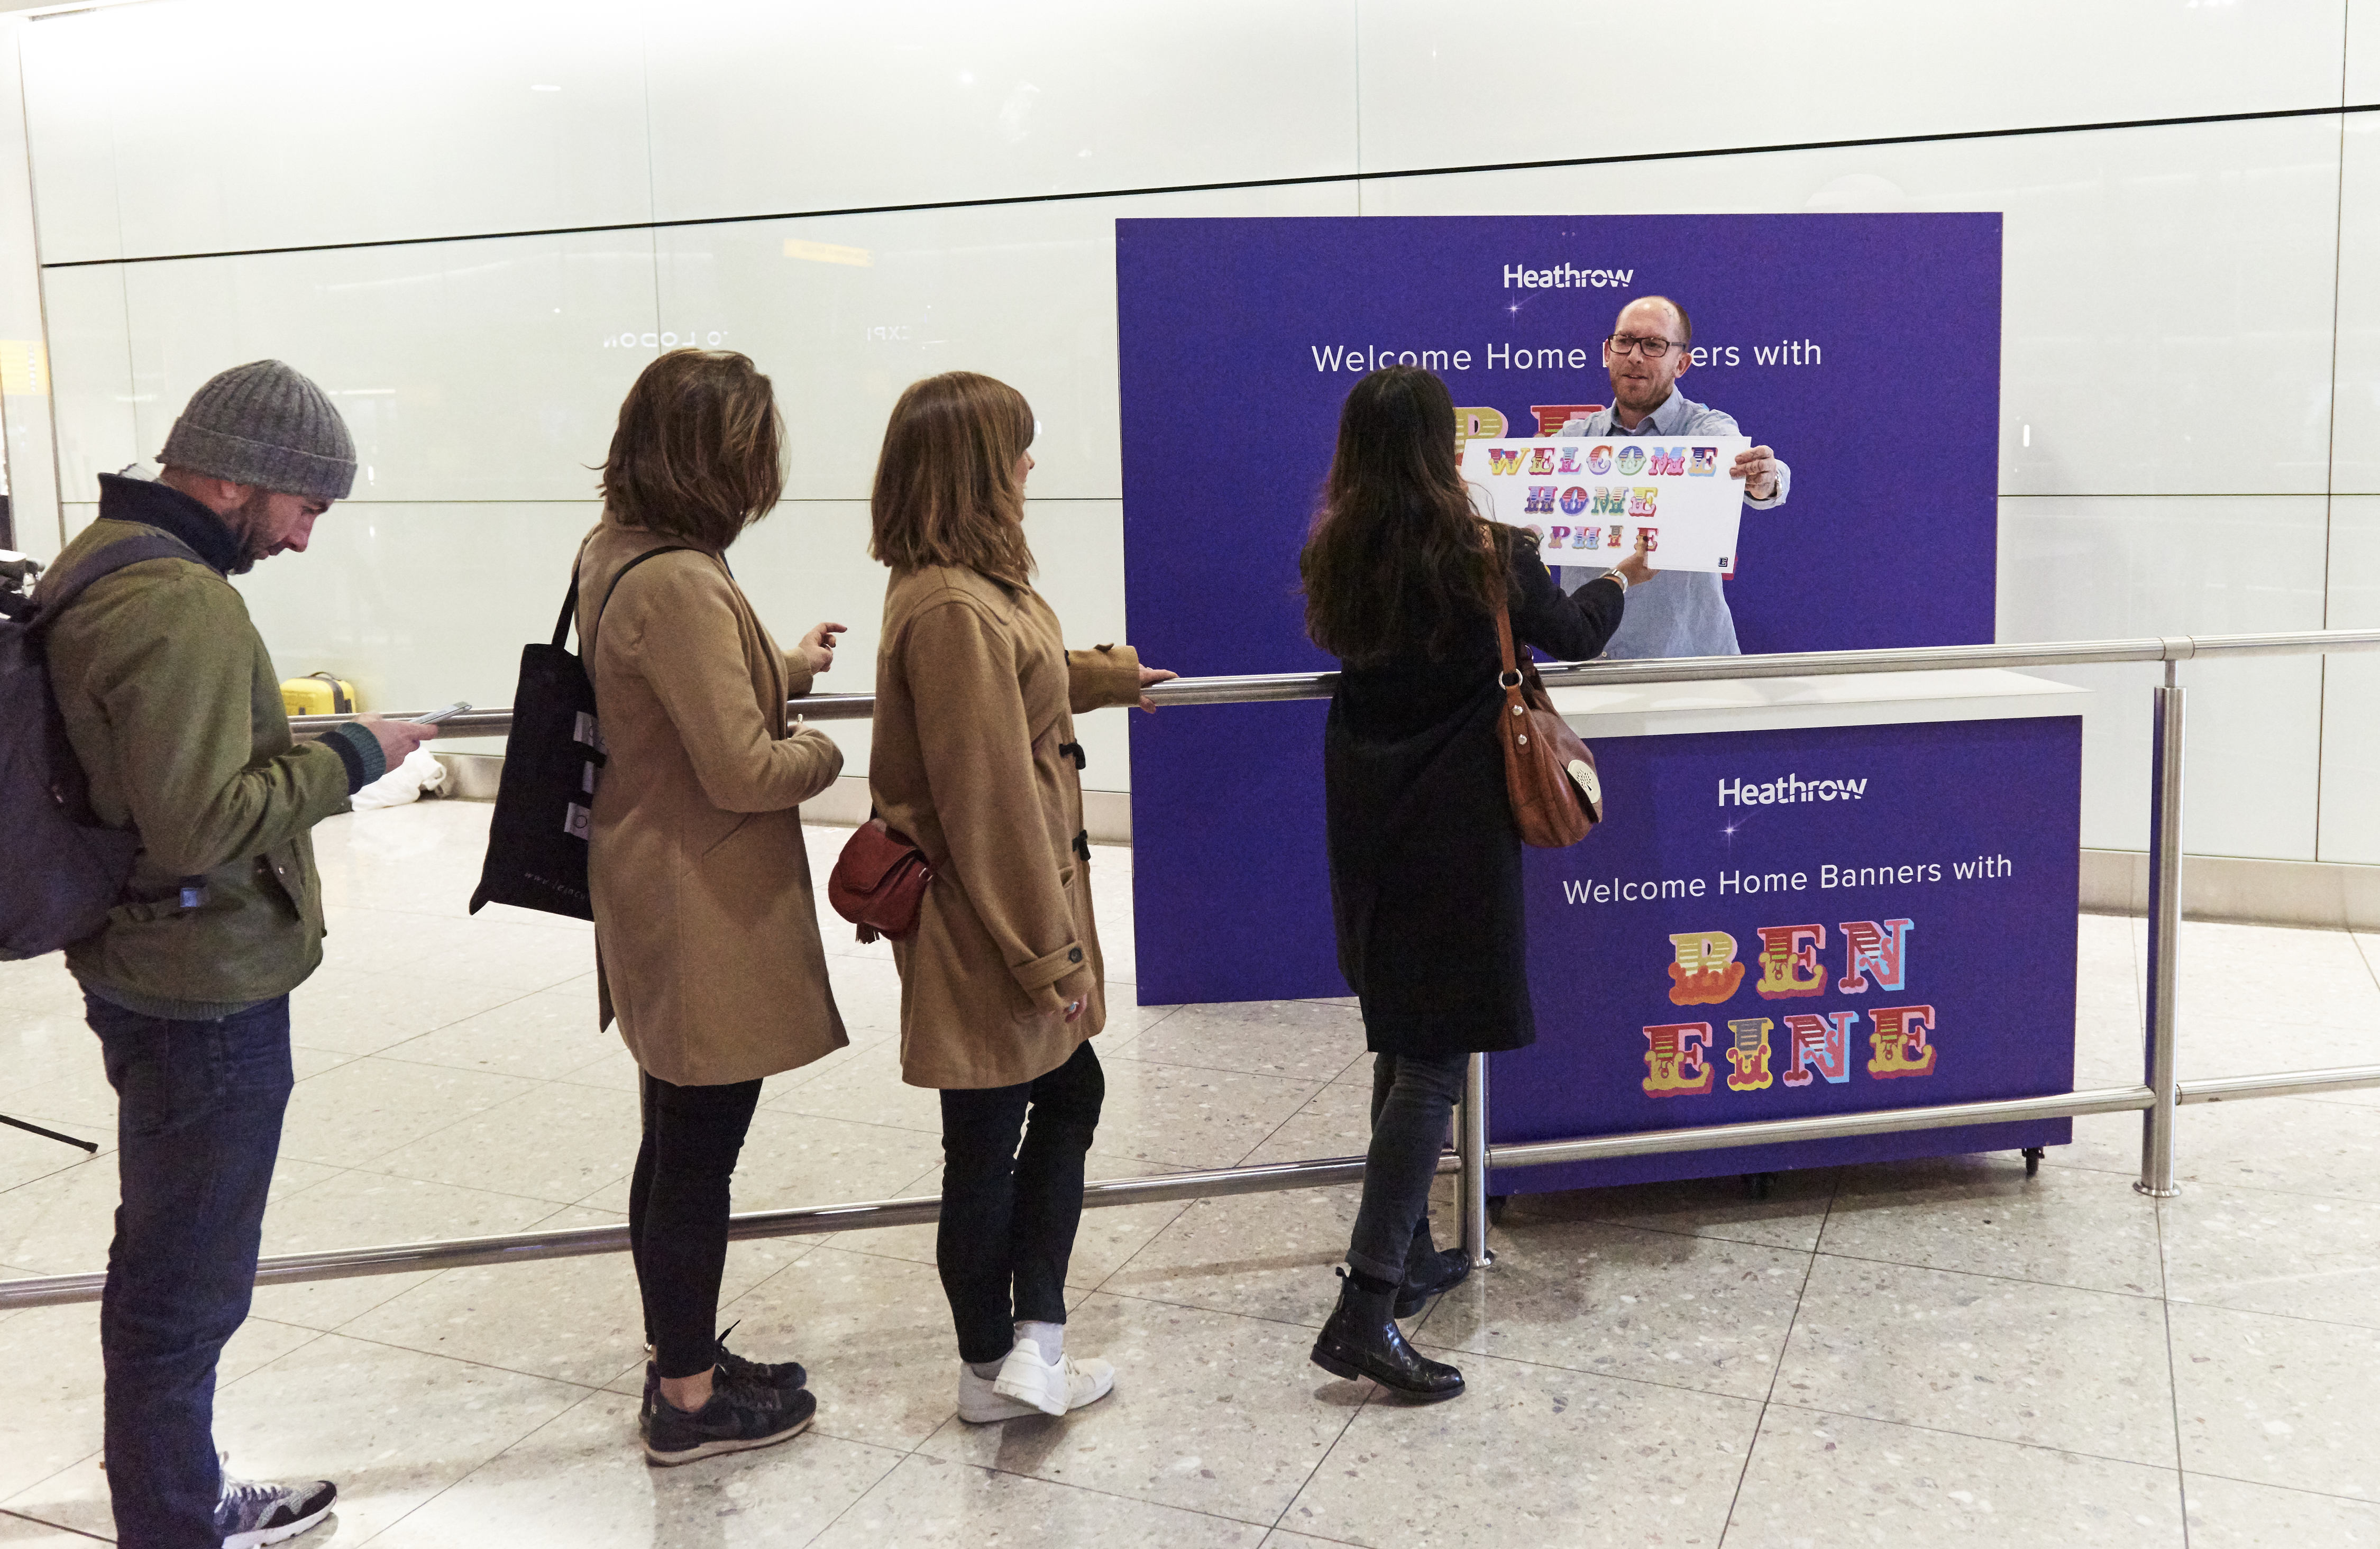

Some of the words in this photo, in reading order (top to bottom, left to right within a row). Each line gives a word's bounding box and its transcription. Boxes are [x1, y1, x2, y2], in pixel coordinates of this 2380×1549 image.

[1504, 262, 1634, 288] Heathrow
[1311, 345, 1471, 371] Welcome
[1487, 343, 1587, 370] Home
[1753, 339, 1821, 365] with
[1488, 445, 1718, 478] WELCOME
[1524, 485, 1659, 518] HOME
[1719, 773, 1867, 806] Heathrow
[1563, 877, 1706, 905] Welcome
[1719, 869, 1808, 895] Home
[1821, 861, 1942, 889] Banners
[1953, 854, 2012, 881] with
[1668, 918, 1914, 1006] BEN
[1642, 1005, 1937, 1098] EINE
